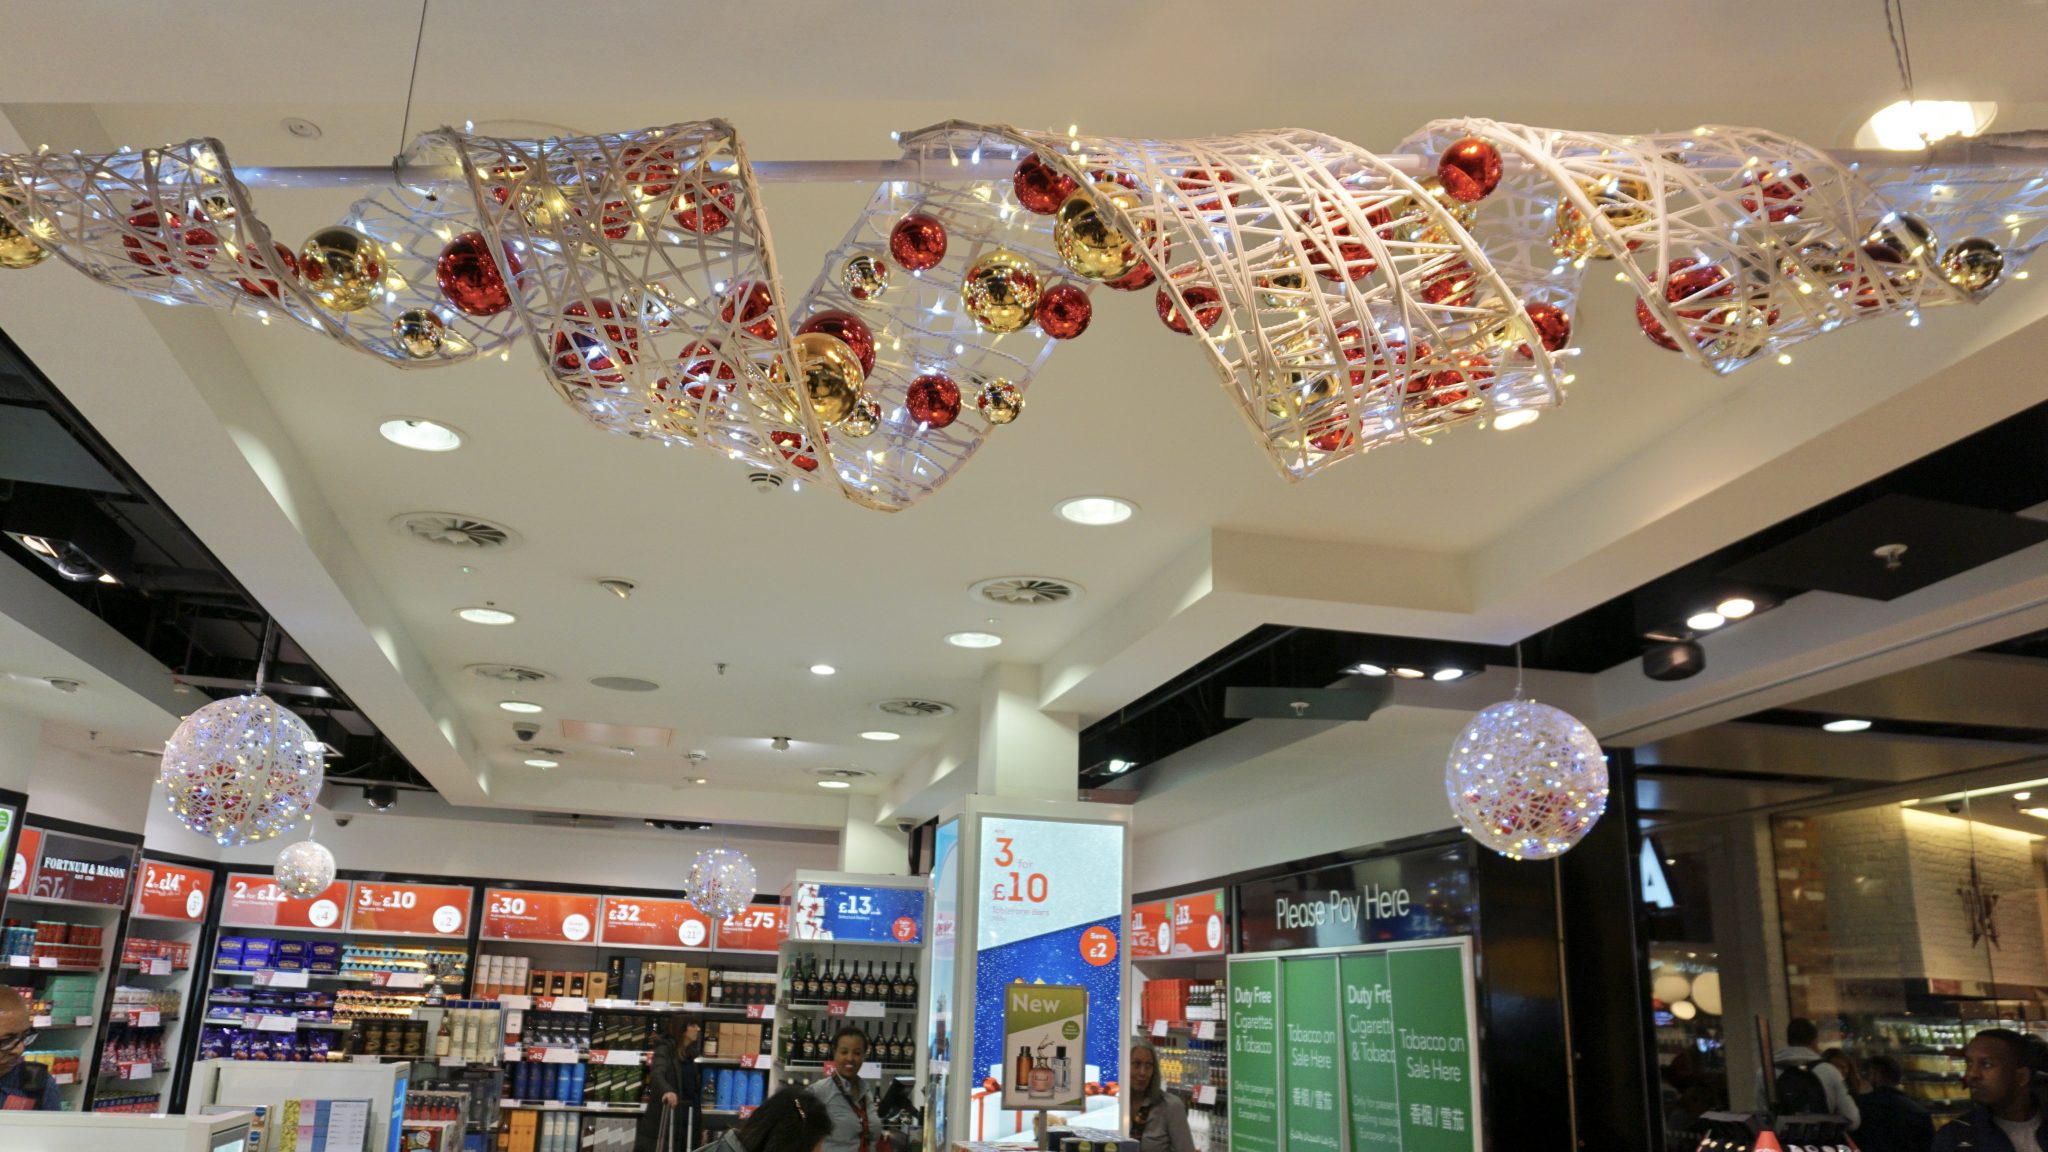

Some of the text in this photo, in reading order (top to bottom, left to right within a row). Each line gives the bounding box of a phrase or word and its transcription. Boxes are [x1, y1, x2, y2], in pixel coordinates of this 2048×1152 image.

[994, 837, 1014, 867] 3
[43, 857, 126, 878] FORTNUM & MASON
[145, 869, 156, 888] 2
[992, 872, 1048, 903] £10
[233, 881, 248, 899] 2
[359, 889, 373, 906] 3
[383, 890, 417, 909] £10
[491, 897, 526, 915] £30
[608, 904, 641, 921] £32
[838, 895, 872, 915] £13
[1276, 883, 1410, 930] Please Pay Here
[744, 911, 775, 929] £75
[1090, 932, 1108, 940] Save
[1089, 943, 1108, 958] £2
[1012, 993, 1061, 1013] New
[1234, 986, 1272, 1009] Duty Free
[1347, 984, 1392, 1010] Duty Fre
[1235, 1011, 1273, 1034] Cigarettes
[1349, 1014, 1392, 1039] Cigarett
[1287, 1023, 1335, 1044] Tobacco on
[1398, 1028, 1465, 1052] Tobacco on
[1235, 1035, 1273, 1054] & Tobacco
[1352, 1041, 1395, 1064] & Tobacc
[1292, 1048, 1332, 1069] Sale Here
[1406, 1056, 1462, 1082] Sale Here
